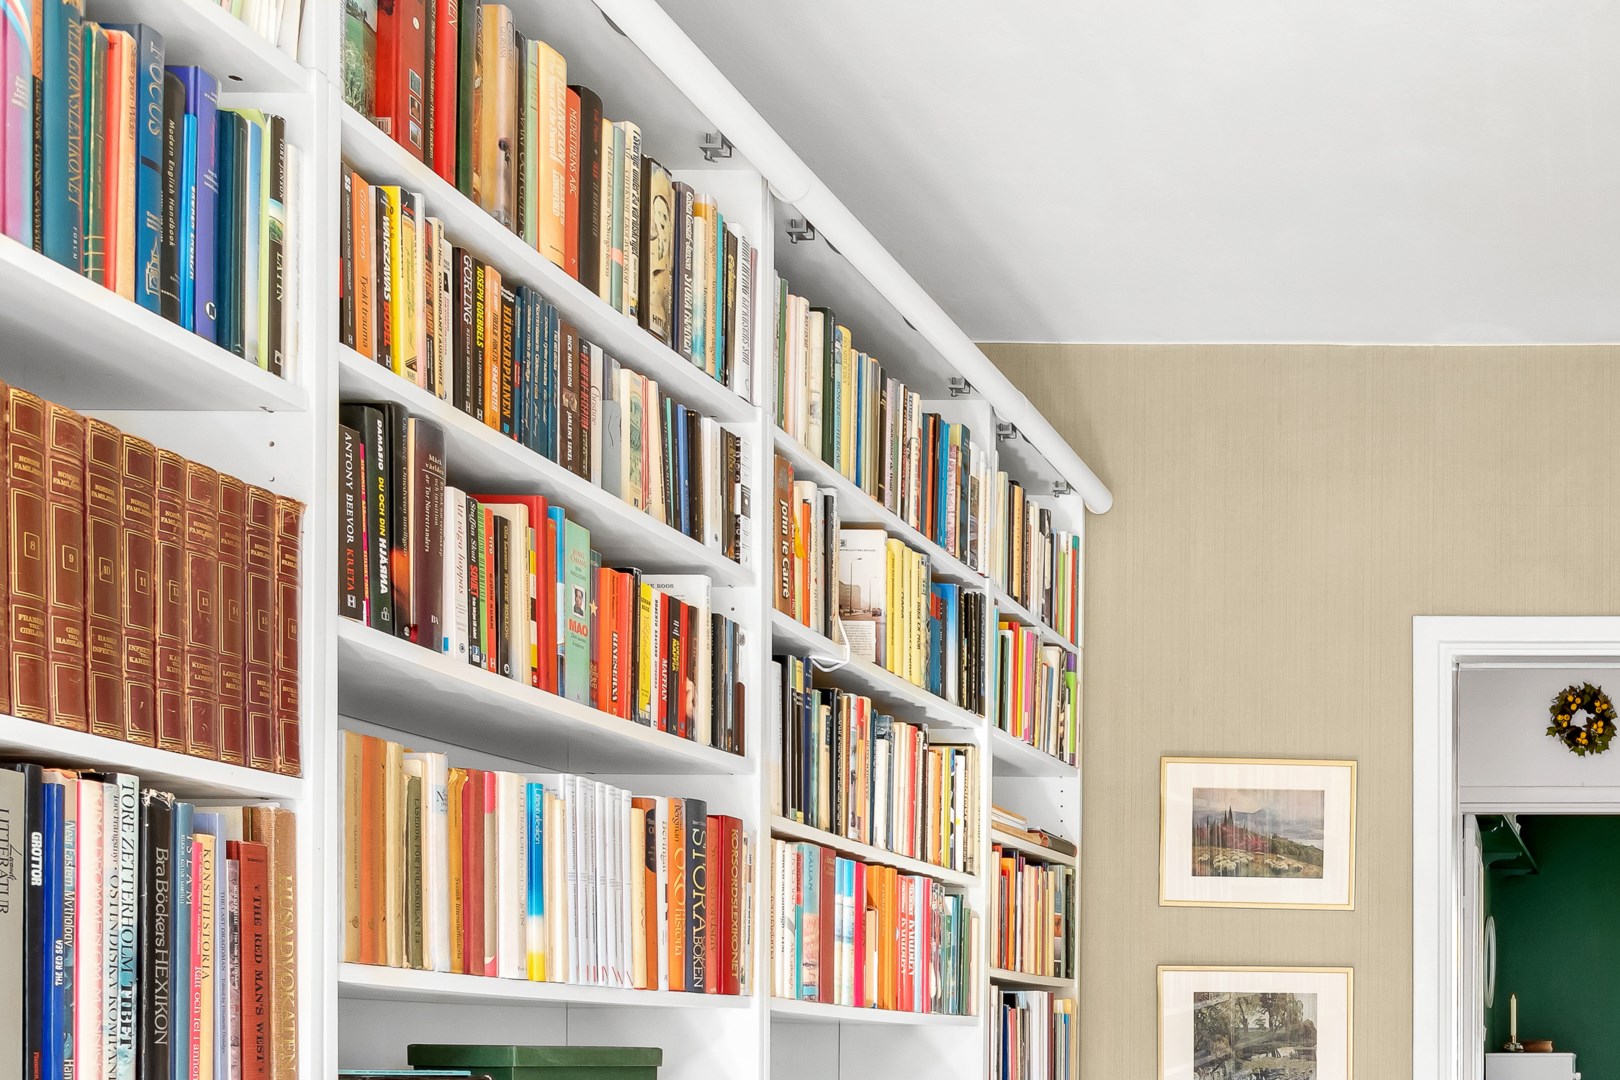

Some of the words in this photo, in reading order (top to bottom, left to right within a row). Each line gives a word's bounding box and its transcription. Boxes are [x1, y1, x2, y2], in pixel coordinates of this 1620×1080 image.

[148, 42, 164, 138] FOCUS
[68, 18, 82, 208] RELIGIONSLEXIKONET
[168, 120, 176, 156] Modern
[568, 107, 578, 173] MEDELTIDENS
[167, 160, 176, 194] English
[344, 175, 351, 191] SS
[569, 175, 577, 199] ABC
[168, 198, 176, 246] Handbook
[276, 252, 284, 301] LATIN
[382, 215, 392, 301] WARSZAWAS
[359, 275, 370, 305] Tyskt
[476, 266, 484, 301] JOSEPH
[361, 308, 369, 348] trauma
[476, 301, 485, 348] GOEBBELS
[502, 304, 513, 418] HÄRSKARPLANEN
[566, 354, 574, 388] HARRISON
[566, 411, 574, 441] JARLENS
[345, 432, 354, 490] ANTONY
[378, 477, 384, 490] DU
[345, 493, 354, 544] BEEVOR
[469, 501, 477, 537] Staffan
[779, 500, 790, 535] John
[781, 540, 790, 555] le
[346, 548, 355, 591] KRETA
[469, 565, 478, 598] SOVJET
[782, 556, 790, 598] Carré
[568, 618, 588, 637] MAO
[121, 782, 135, 831] TORE
[672, 804, 682, 843] Bergman
[65, 821, 75, 845] Near
[31, 831, 42, 886] GROTTOR
[65, 848, 75, 887] Eastern
[155, 847, 168, 878] Bra
[64, 890, 75, 947] Mythology
[120, 836, 134, 974] ZETTERHOLM
[154, 881, 169, 947] Böckers
[202, 848, 212, 980] KONSTHISTORIA
[252, 895, 263, 926] THE
[730, 828, 739, 980] KORSORDSLEXIKONET
[254, 933, 263, 964] RED
[692, 935, 704, 988] BOKEN
[255, 970, 265, 1015] MAN'S
[279, 874, 296, 1072] HUSADVOKATEN
[120, 981, 133, 1050] TIBET
[154, 949, 168, 1045] HEXIKON
[256, 1022, 265, 1063] WEST
